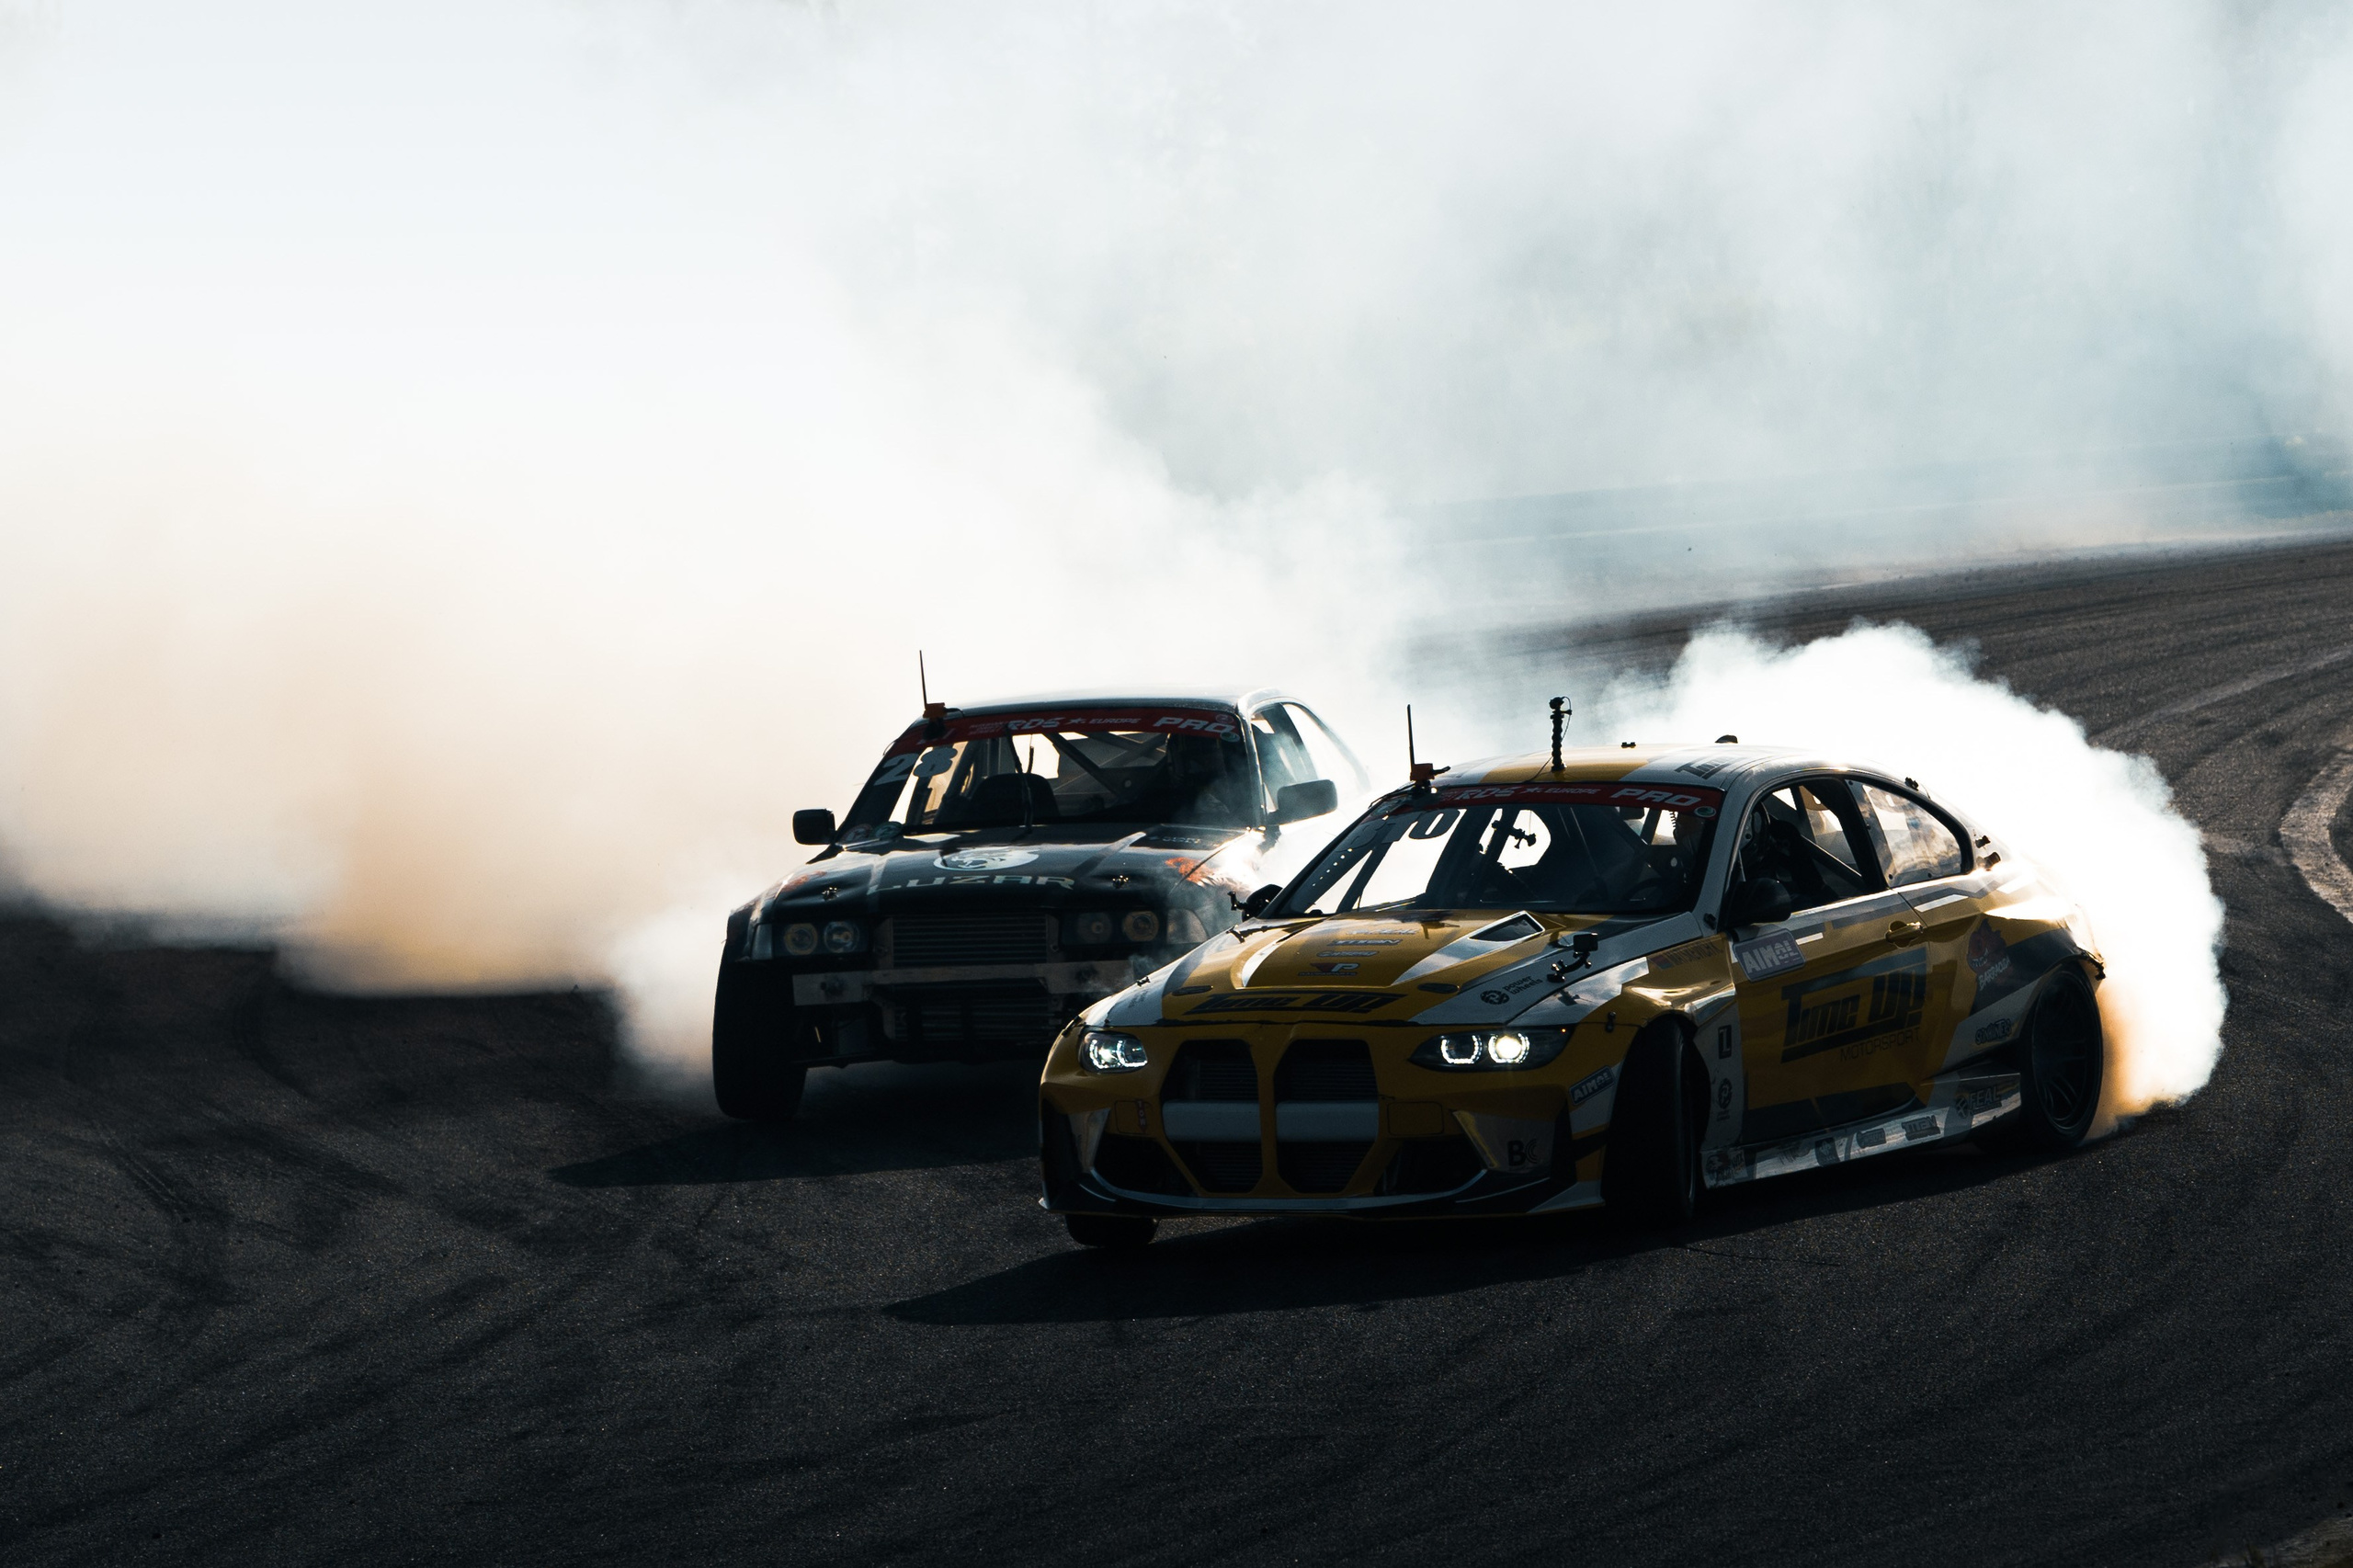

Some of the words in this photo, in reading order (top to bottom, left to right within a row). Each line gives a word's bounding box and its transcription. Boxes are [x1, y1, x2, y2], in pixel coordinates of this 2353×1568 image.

[1007, 716, 1065, 731] RDS
[1153, 717, 1234, 733] PRO
[1454, 786, 1522, 801] RDS
[1610, 788, 1701, 806] PRO
[867, 875, 1074, 895] LUZAR
[1502, 976, 1532, 991] power
[1510, 979, 1543, 994] wheels
[1840, 1028, 1921, 1061] MOTORSPORT
